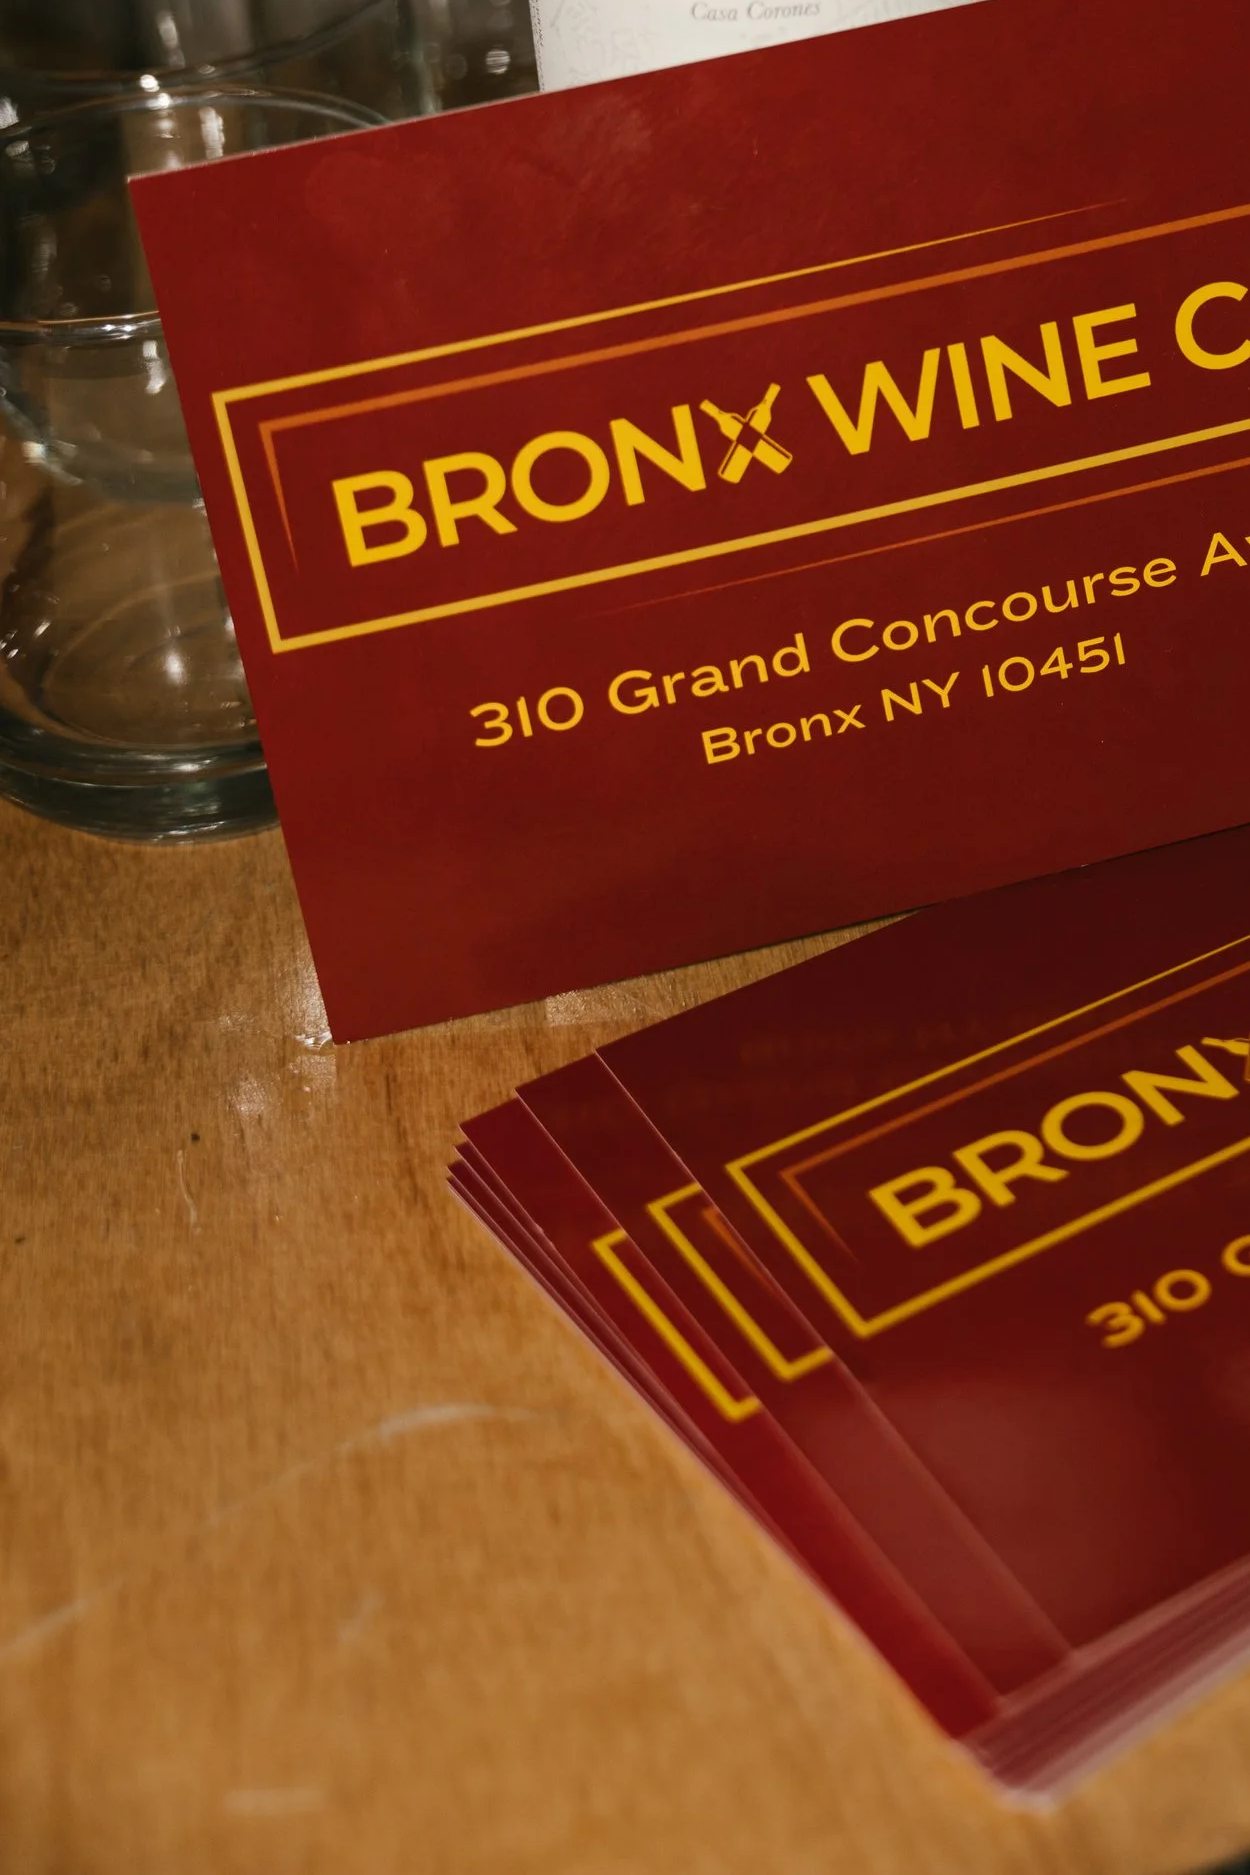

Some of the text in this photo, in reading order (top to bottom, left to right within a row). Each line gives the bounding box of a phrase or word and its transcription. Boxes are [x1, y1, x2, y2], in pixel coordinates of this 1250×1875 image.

[690, 0, 821, 22] Casa Corones
[332, 383, 793, 567] BRONX
[806, 303, 1151, 456] WINE
[470, 686, 585, 747] 310
[608, 633, 811, 715] Grand
[831, 556, 1177, 662] Concourse
[702, 632, 1126, 765] Bronx NY 10451
[1088, 1269, 1211, 1346] 310
